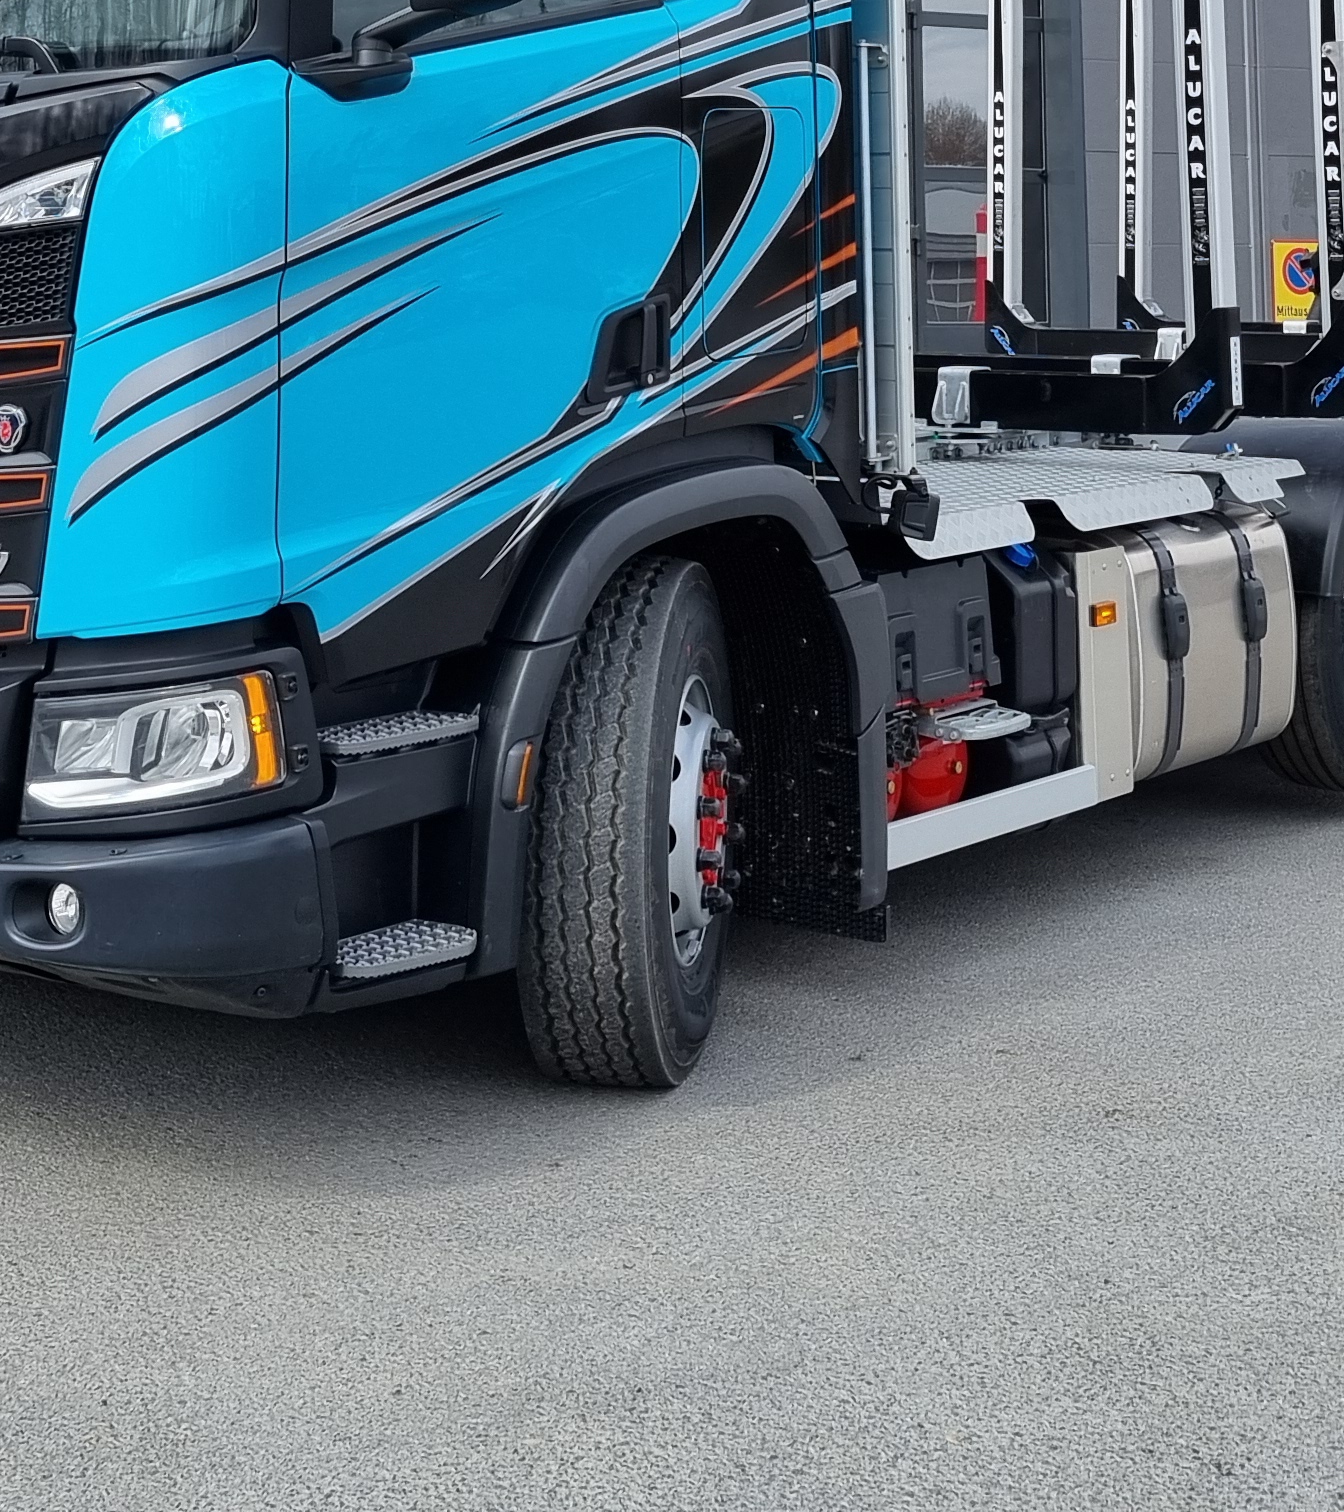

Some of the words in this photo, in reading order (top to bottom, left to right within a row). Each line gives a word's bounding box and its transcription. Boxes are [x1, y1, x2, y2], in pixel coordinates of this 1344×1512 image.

[994, 91, 1004, 194] ALUCAR
[1125, 99, 1136, 195] ALUCAR
[1185, 28, 1206, 179] ALUCAR
[1322, 56, 1341, 182] LUCAR
[1276, 305, 1308, 317] Mittaus
